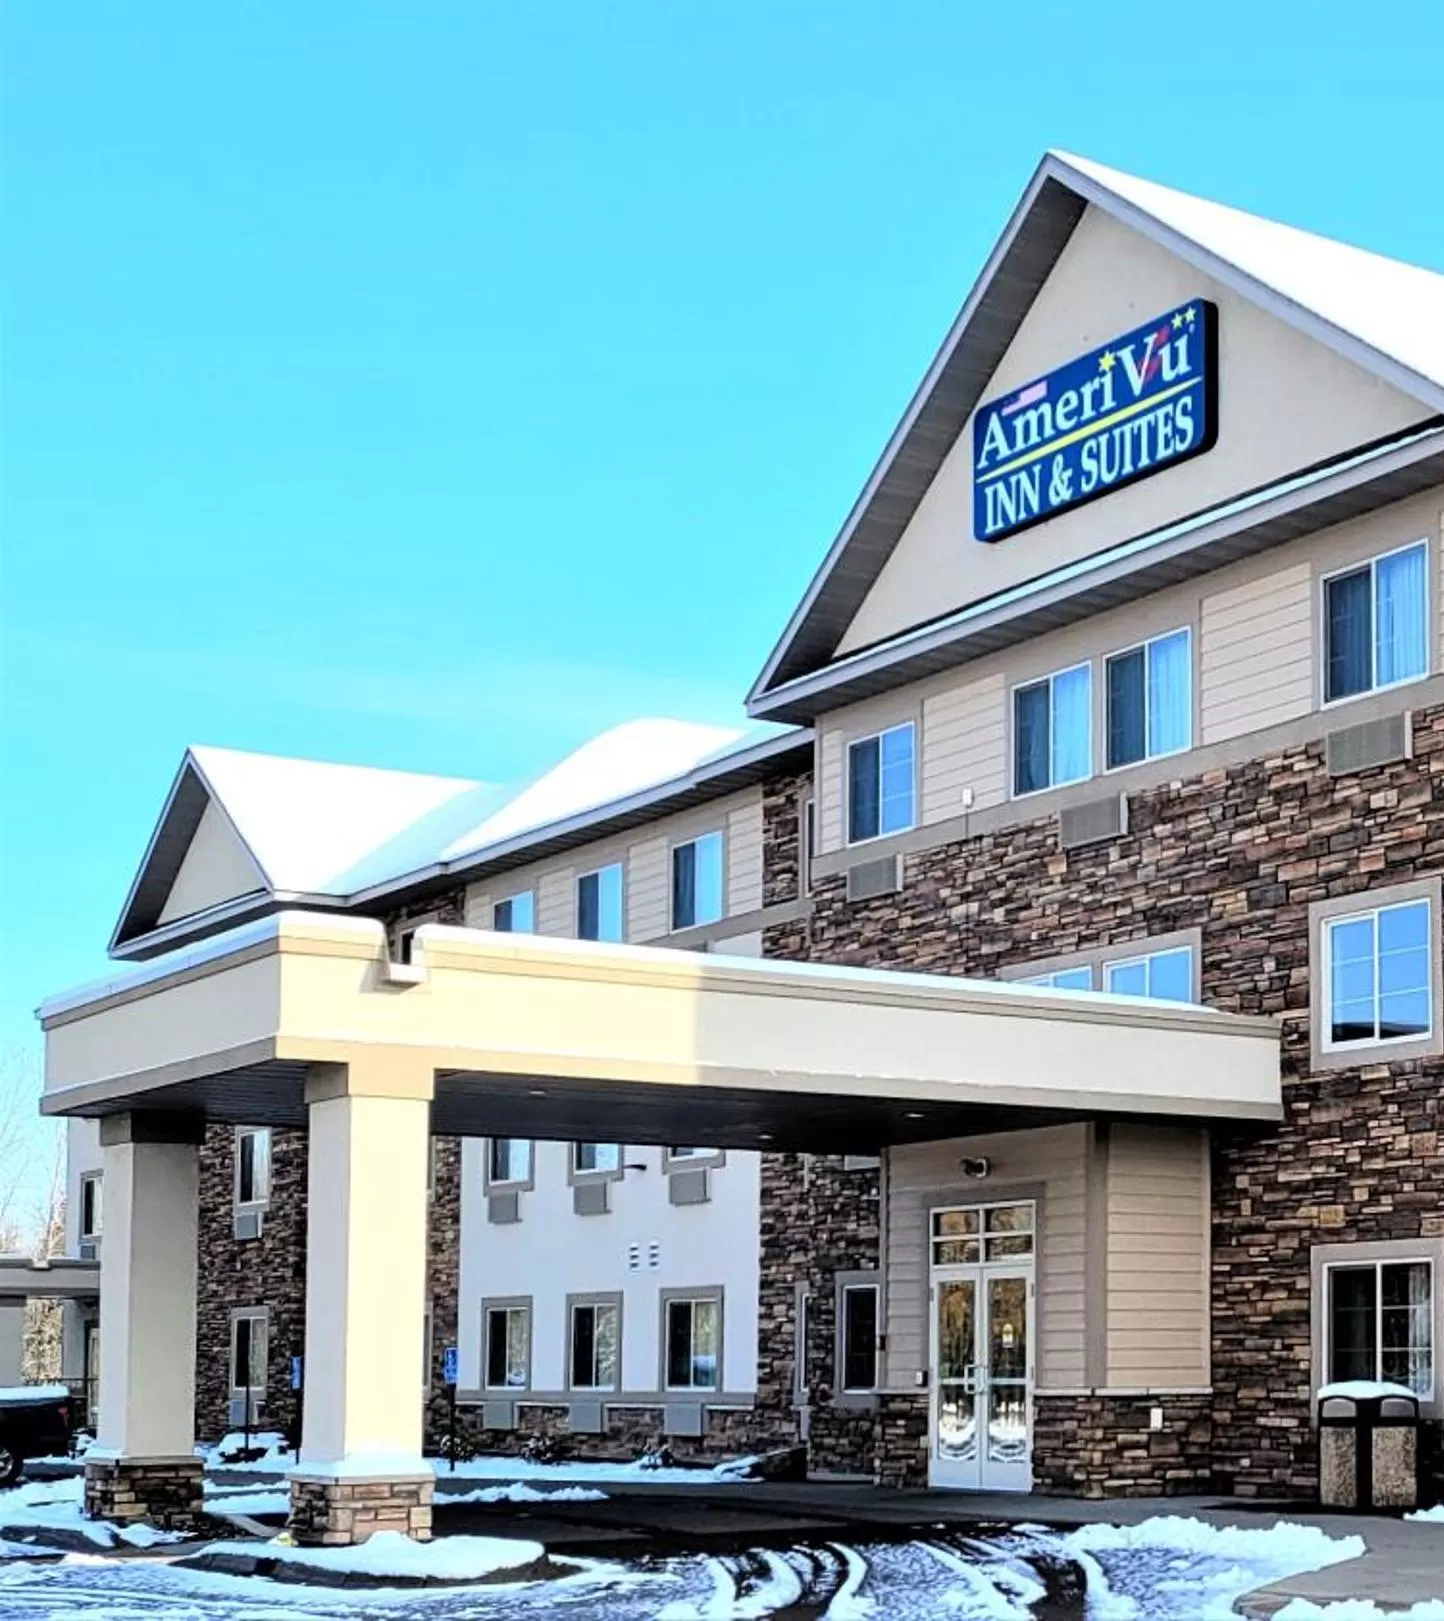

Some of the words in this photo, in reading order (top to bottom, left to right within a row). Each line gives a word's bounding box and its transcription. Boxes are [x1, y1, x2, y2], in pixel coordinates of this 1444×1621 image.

[977, 332, 1192, 469] AmeriVu
[984, 465, 1042, 534] INN
[1048, 453, 1073, 506] &
[1081, 396, 1193, 492] SUITES
